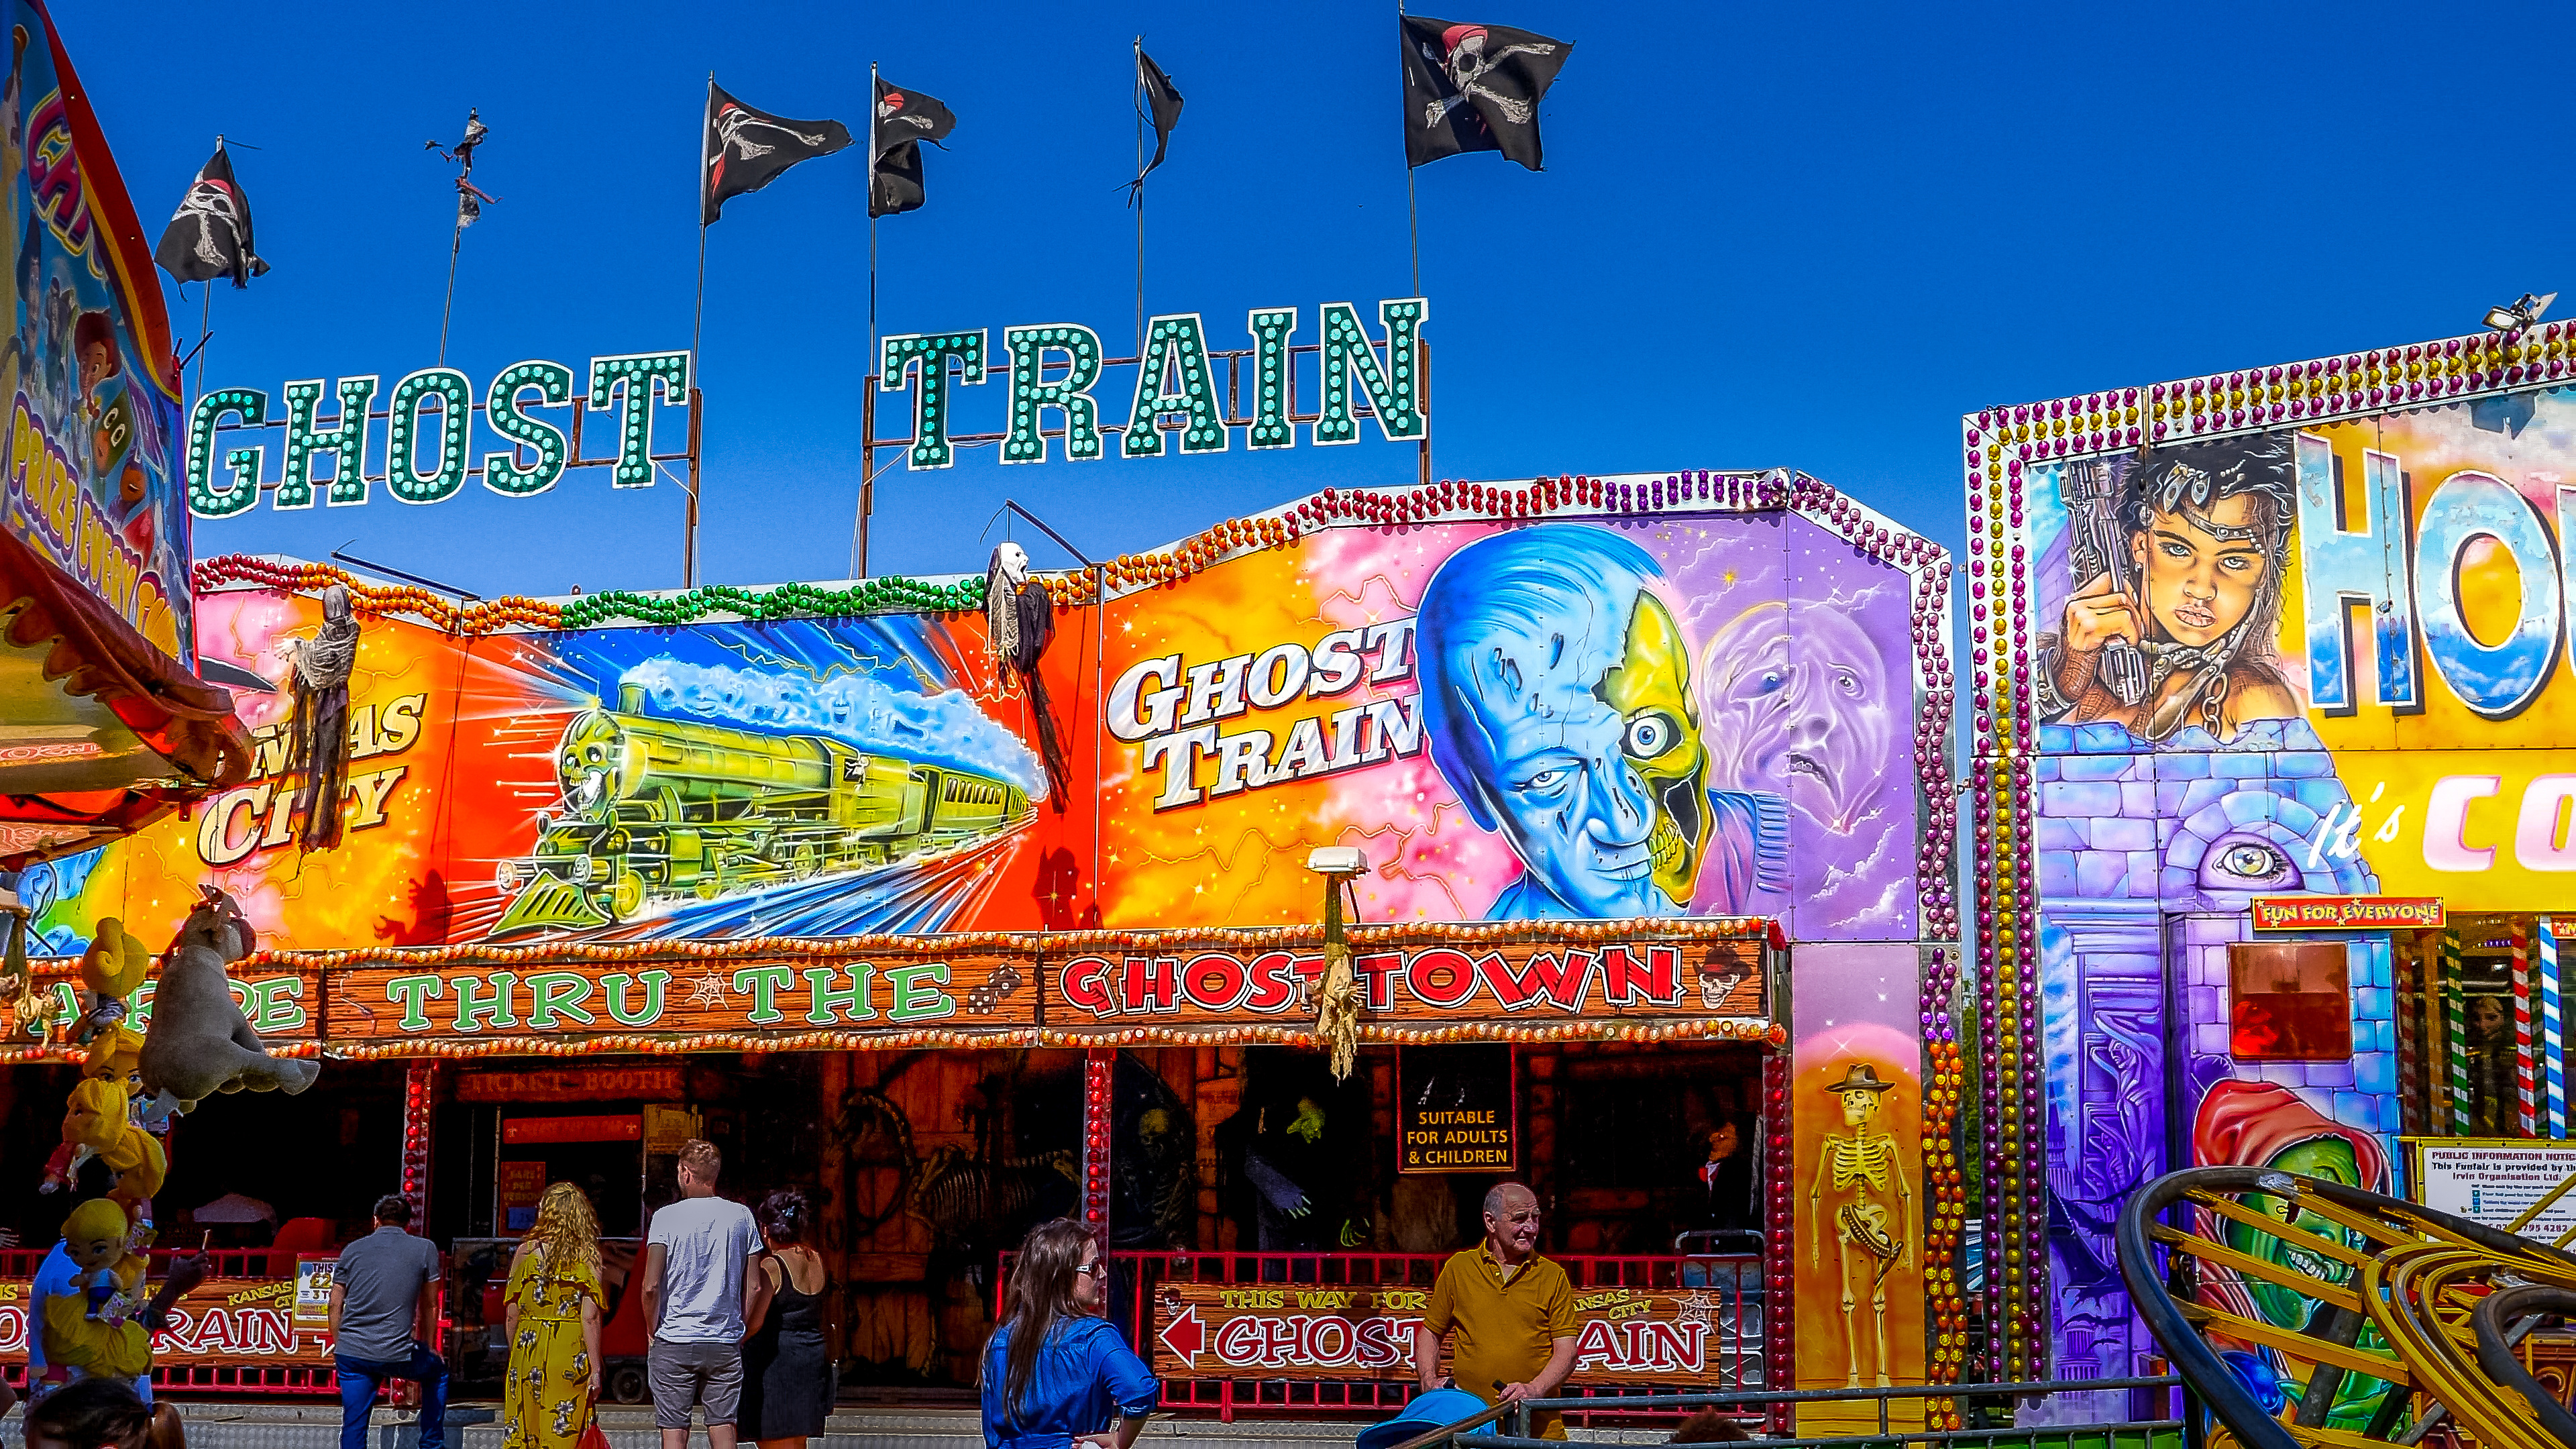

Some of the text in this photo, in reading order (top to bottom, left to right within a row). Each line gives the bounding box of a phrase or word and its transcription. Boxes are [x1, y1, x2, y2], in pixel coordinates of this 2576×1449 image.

[187, 297, 1429, 519] GHOST TRAIN
[10, 397, 78, 558] PRIZE
[2293, 431, 2576, 715] HO
[1106, 615, 1417, 743] GHOST
[1142, 692, 1423, 814] TRAIN
[197, 765, 409, 867] CIY
[2307, 782, 2406, 869] It's
[2263, 904, 2440, 920] FUN FOR EVERYONE
[386, 969, 672, 1033] THRU
[733, 962, 956, 1024] THE
[1354, 945, 1686, 1013] TOWN
[582, 1071, 678, 1091] BOOTH
[1418, 1110, 1495, 1124] SUITABLE
[1407, 1130, 1507, 1144] FOR ADULTS
[1409, 1150, 1507, 1164] & CHILDREN
[2432, 1162, 2452, 1171] This
[2455, 1162, 2490, 1171] Funfair
[2506, 1163, 2548, 1173] provided
[2471, 1152, 2542, 1161] INFORMATION
[2479, 1172, 2540, 1181] Organisation
[313, 1263, 333, 1273] THIS
[227, 1281, 292, 1306] KANSAS
[1220, 1290, 1427, 1309] THIS WAY FOR
[1609, 1299, 1652, 1320] CITY
[150, 1307, 299, 1355] RAIN
[1214, 1315, 1710, 1373] GHOST AIN
